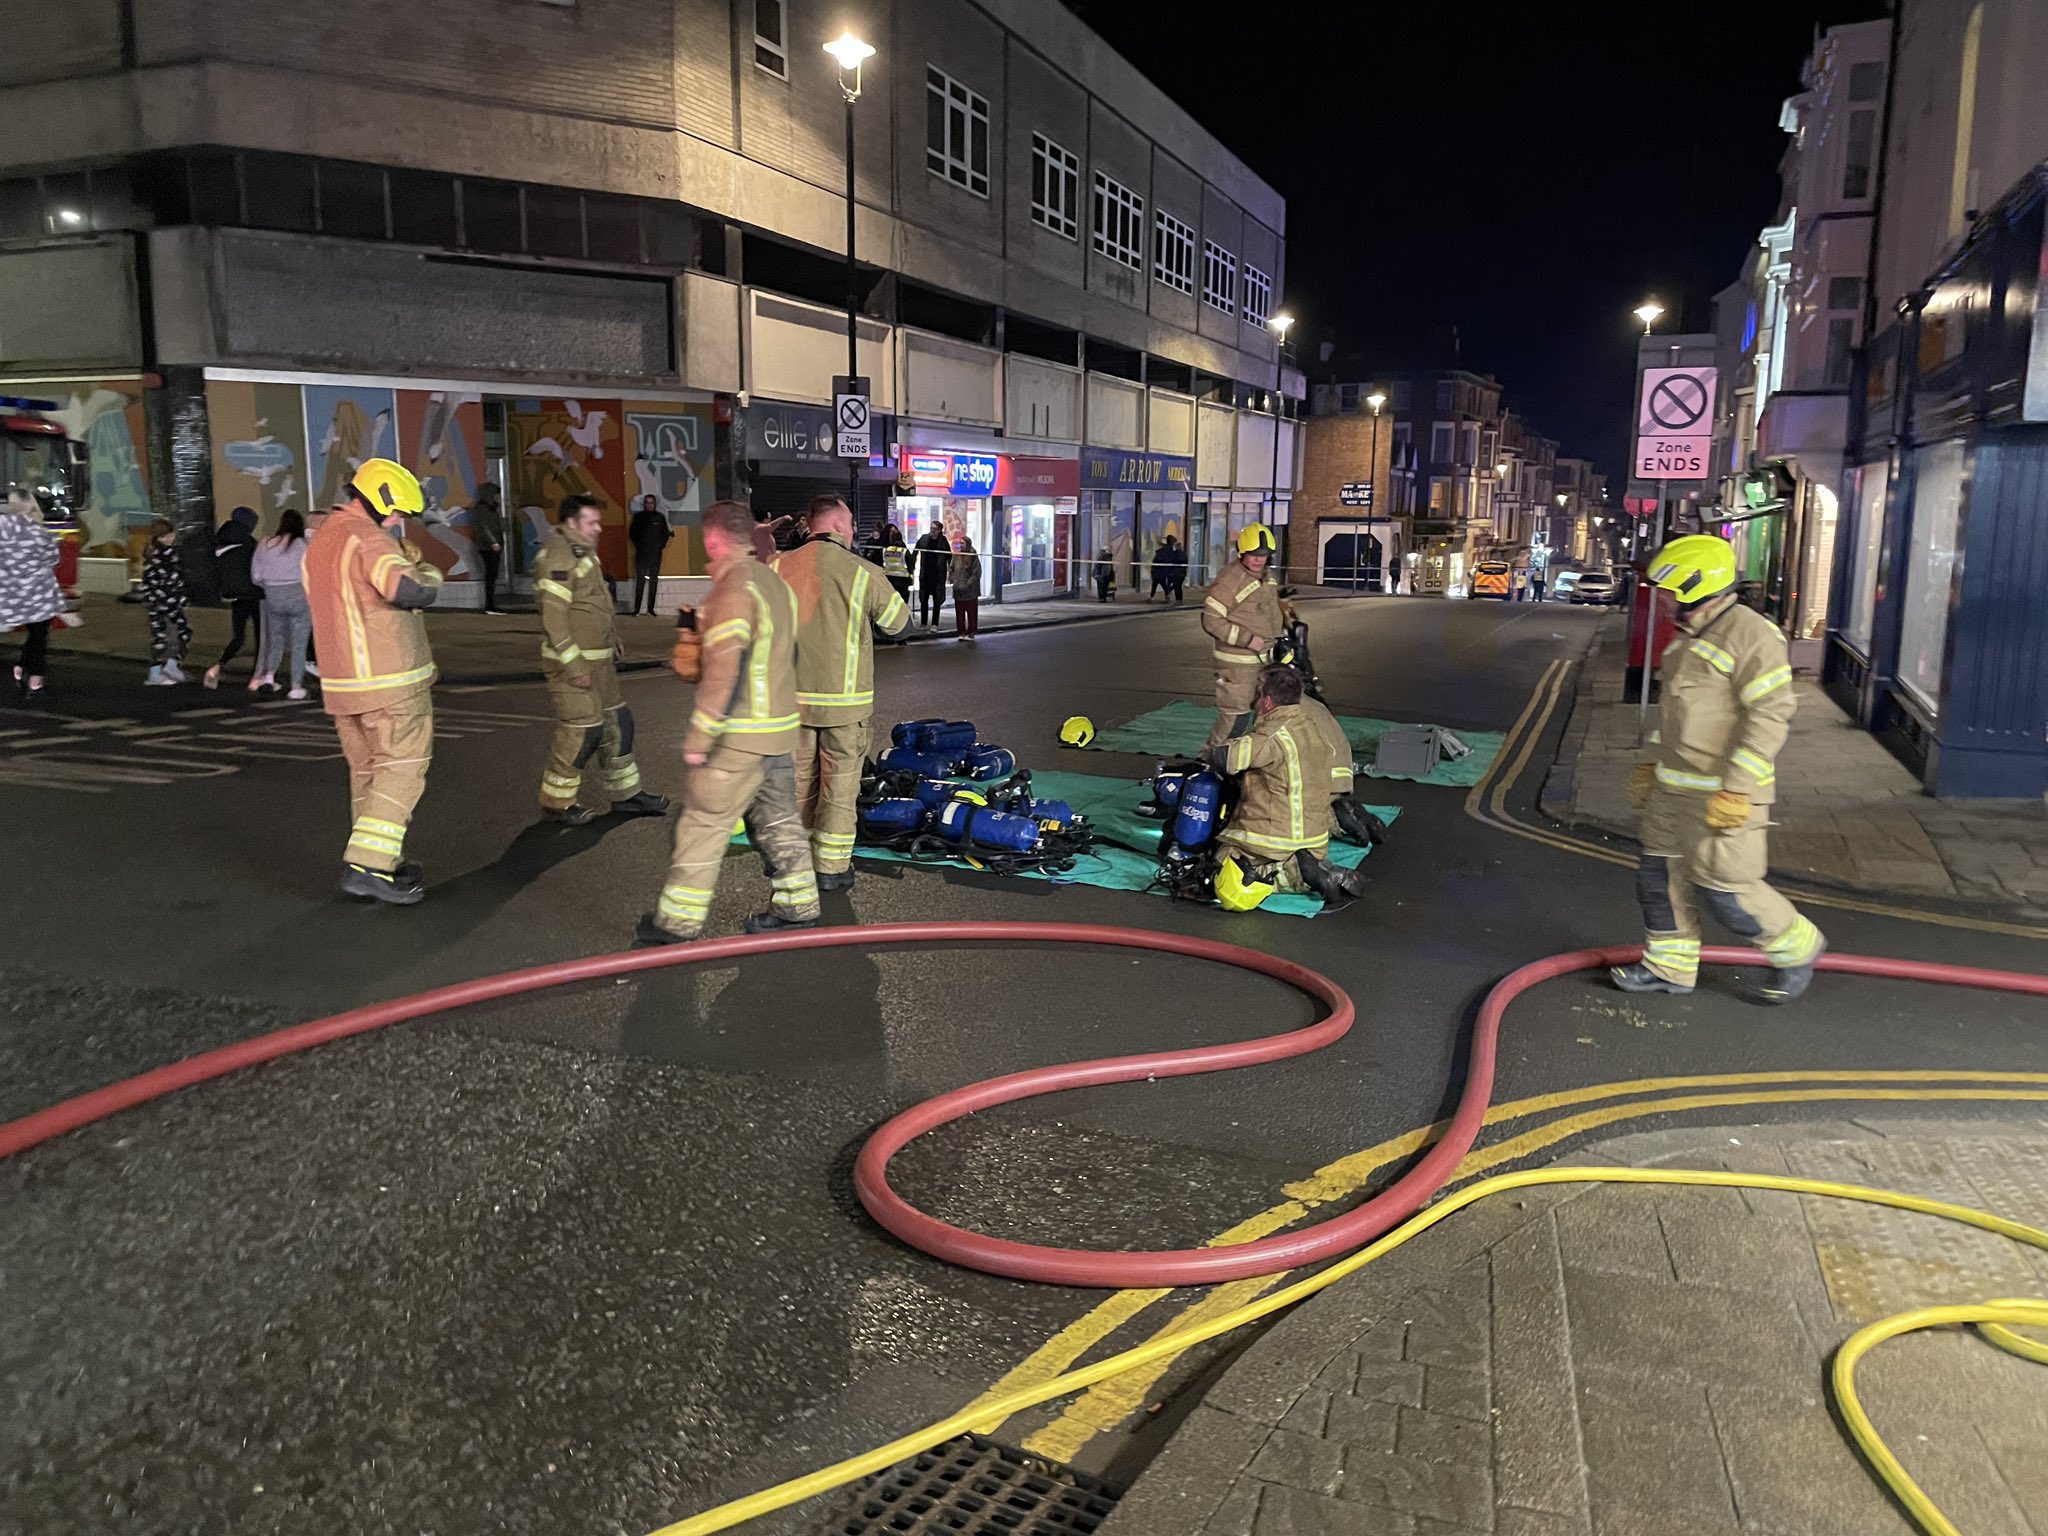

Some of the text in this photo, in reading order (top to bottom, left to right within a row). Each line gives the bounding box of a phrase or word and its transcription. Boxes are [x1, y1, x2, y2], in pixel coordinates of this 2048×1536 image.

[845, 435, 862, 443] Zone
[840, 445, 867, 453] ENDS
[1656, 441, 1692, 453] Zone
[1119, 458, 1162, 483] ARROW
[1643, 458, 1702, 471] ENDS
[954, 463, 969, 481] ne
[969, 459, 994, 489] stop
